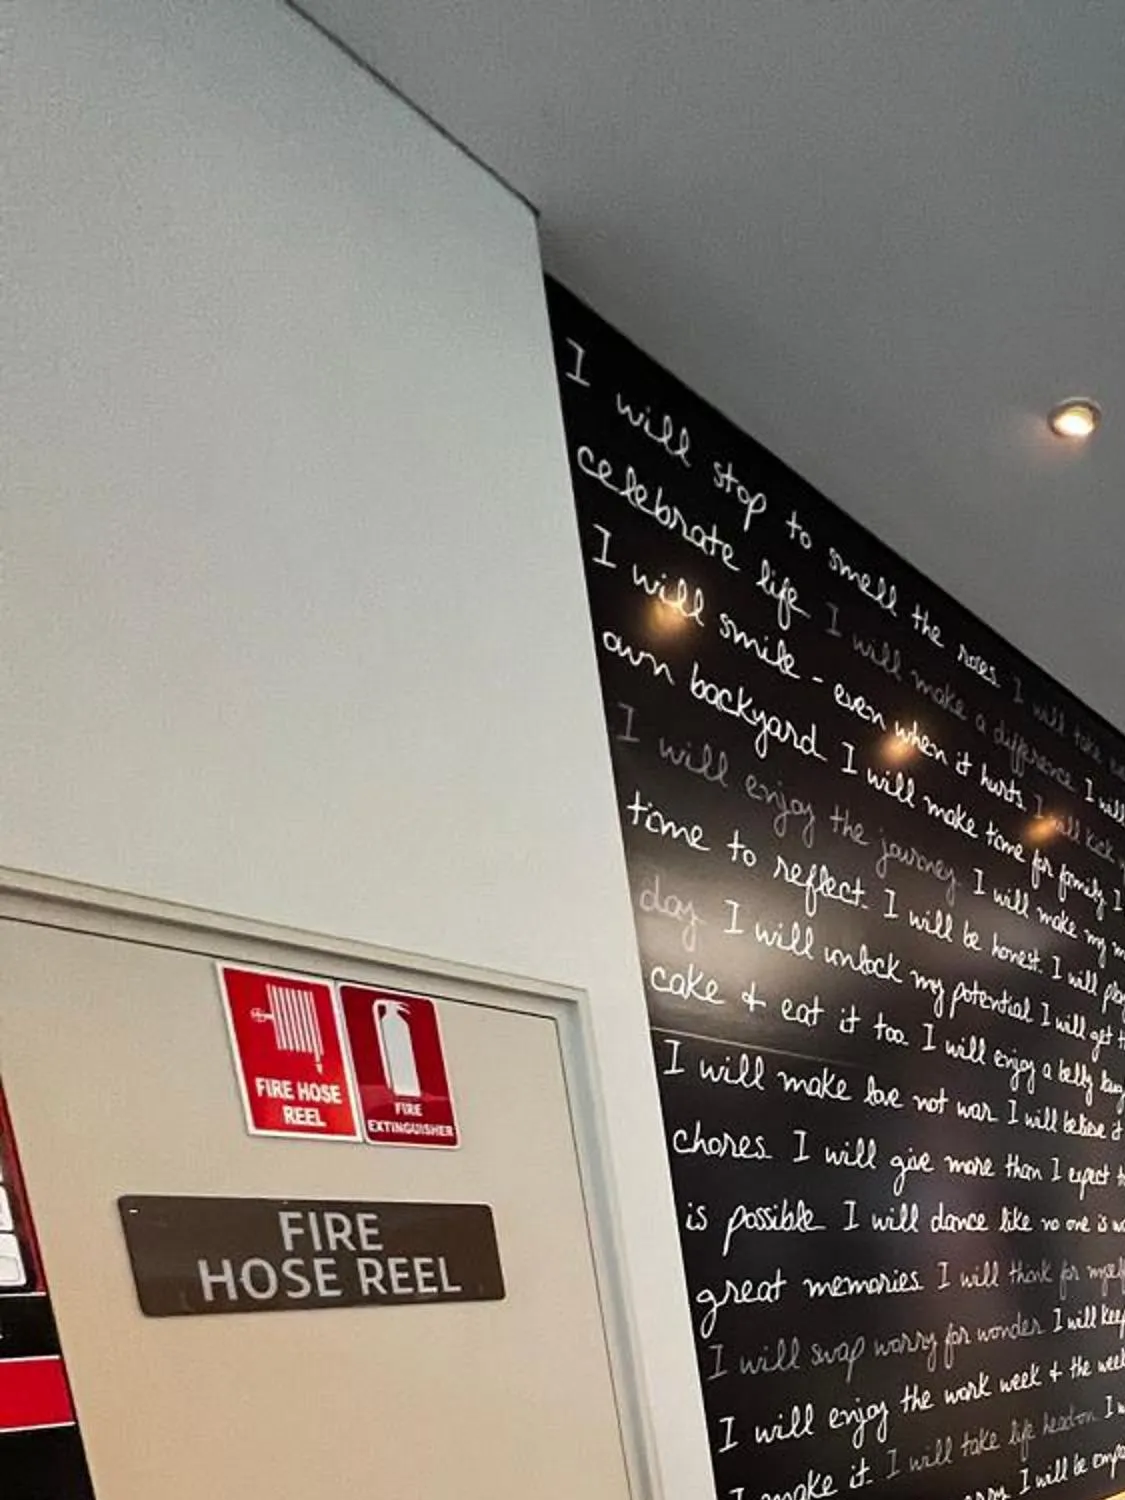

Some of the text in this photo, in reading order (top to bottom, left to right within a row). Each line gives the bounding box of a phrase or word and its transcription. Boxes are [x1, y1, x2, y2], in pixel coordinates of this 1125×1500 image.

[565, 337, 590, 387] I
[616, 393, 690, 467] will
[713, 461, 767, 531] stop
[785, 510, 812, 550] to
[829, 547, 897, 617] smell
[911, 604, 944, 648] the
[577, 446, 739, 571] celebrate
[825, 601, 841, 637] I
[852, 636, 901, 681] will
[910, 669, 967, 721] make
[974, 712, 986, 734] a
[592, 523, 617, 569] I
[632, 564, 704, 626] will
[719, 612, 800, 679] smile
[833, 682, 886, 730] even
[892, 720, 948, 765] when
[954, 751, 973, 777] it
[602, 630, 674, 684] own
[841, 741, 858, 775] I
[866, 767, 915, 808] will
[922, 795, 978, 839] make
[615, 702, 640, 743] I
[659, 738, 728, 787] will
[745, 774, 815, 848] enjoy
[829, 805, 869, 846] the
[972, 867, 986, 895] I
[626, 790, 710, 851] time
[726, 829, 757, 868] to
[883, 887, 899, 919] I
[908, 909, 953, 943] will
[962, 919, 983, 951] be
[639, 875, 704, 952] day
[723, 898, 744, 935] I
[754, 921, 814, 960] will
[823, 943, 903, 983] unlock
[909, 969, 945, 1019] my
[649, 963, 725, 1005] cake
[780, 995, 825, 1027] eat
[838, 1004, 861, 1034] it
[921, 1022, 937, 1051] I
[944, 1035, 986, 1065] will
[255, 1078, 342, 1104] FIRE HOSE
[283, 1106, 327, 1127] REEL
[394, 1102, 423, 1117] FIRE
[662, 1039, 686, 1075] I
[699, 1053, 766, 1091] will
[776, 1069, 852, 1101] make
[863, 1074, 904, 1109] love
[911, 1087, 949, 1115] not
[1006, 1098, 1019, 1125] I
[367, 1119, 454, 1138] EXTINGUISHER
[792, 1129, 810, 1163] I
[824, 1137, 877, 1170] will
[889, 1147, 935, 1196] give
[943, 1155, 995, 1177] more
[1004, 1152, 1043, 1181] than
[278, 1211, 384, 1252] FIRE
[684, 1201, 708, 1231] is
[842, 1199, 860, 1231] I
[871, 1202, 919, 1233] will
[929, 1201, 989, 1233] dance
[998, 1205, 1033, 1233] like
[198, 1256, 462, 1302] HOSE REEL
[695, 1268, 787, 1339] great
[937, 1260, 951, 1290] I
[960, 1260, 999, 1288] will
[1008, 1259, 1053, 1284] think
[707, 1343, 728, 1381] I
[739, 1336, 800, 1375] will
[810, 1335, 865, 1383] swap
[873, 1330, 938, 1372] worry
[943, 1322, 972, 1370] for
[718, 1415, 739, 1453] I
[754, 1402, 814, 1444] will
[828, 1397, 889, 1449] enjoy
[899, 1383, 935, 1414] the
[943, 1371, 992, 1405] work
[999, 1362, 1042, 1393] week
[885, 1448, 901, 1480] I
[909, 1435, 953, 1471] will
[960, 1427, 1000, 1457] take
[1018, 1467, 1031, 1495] I
[1035, 1455, 1068, 1488] will
